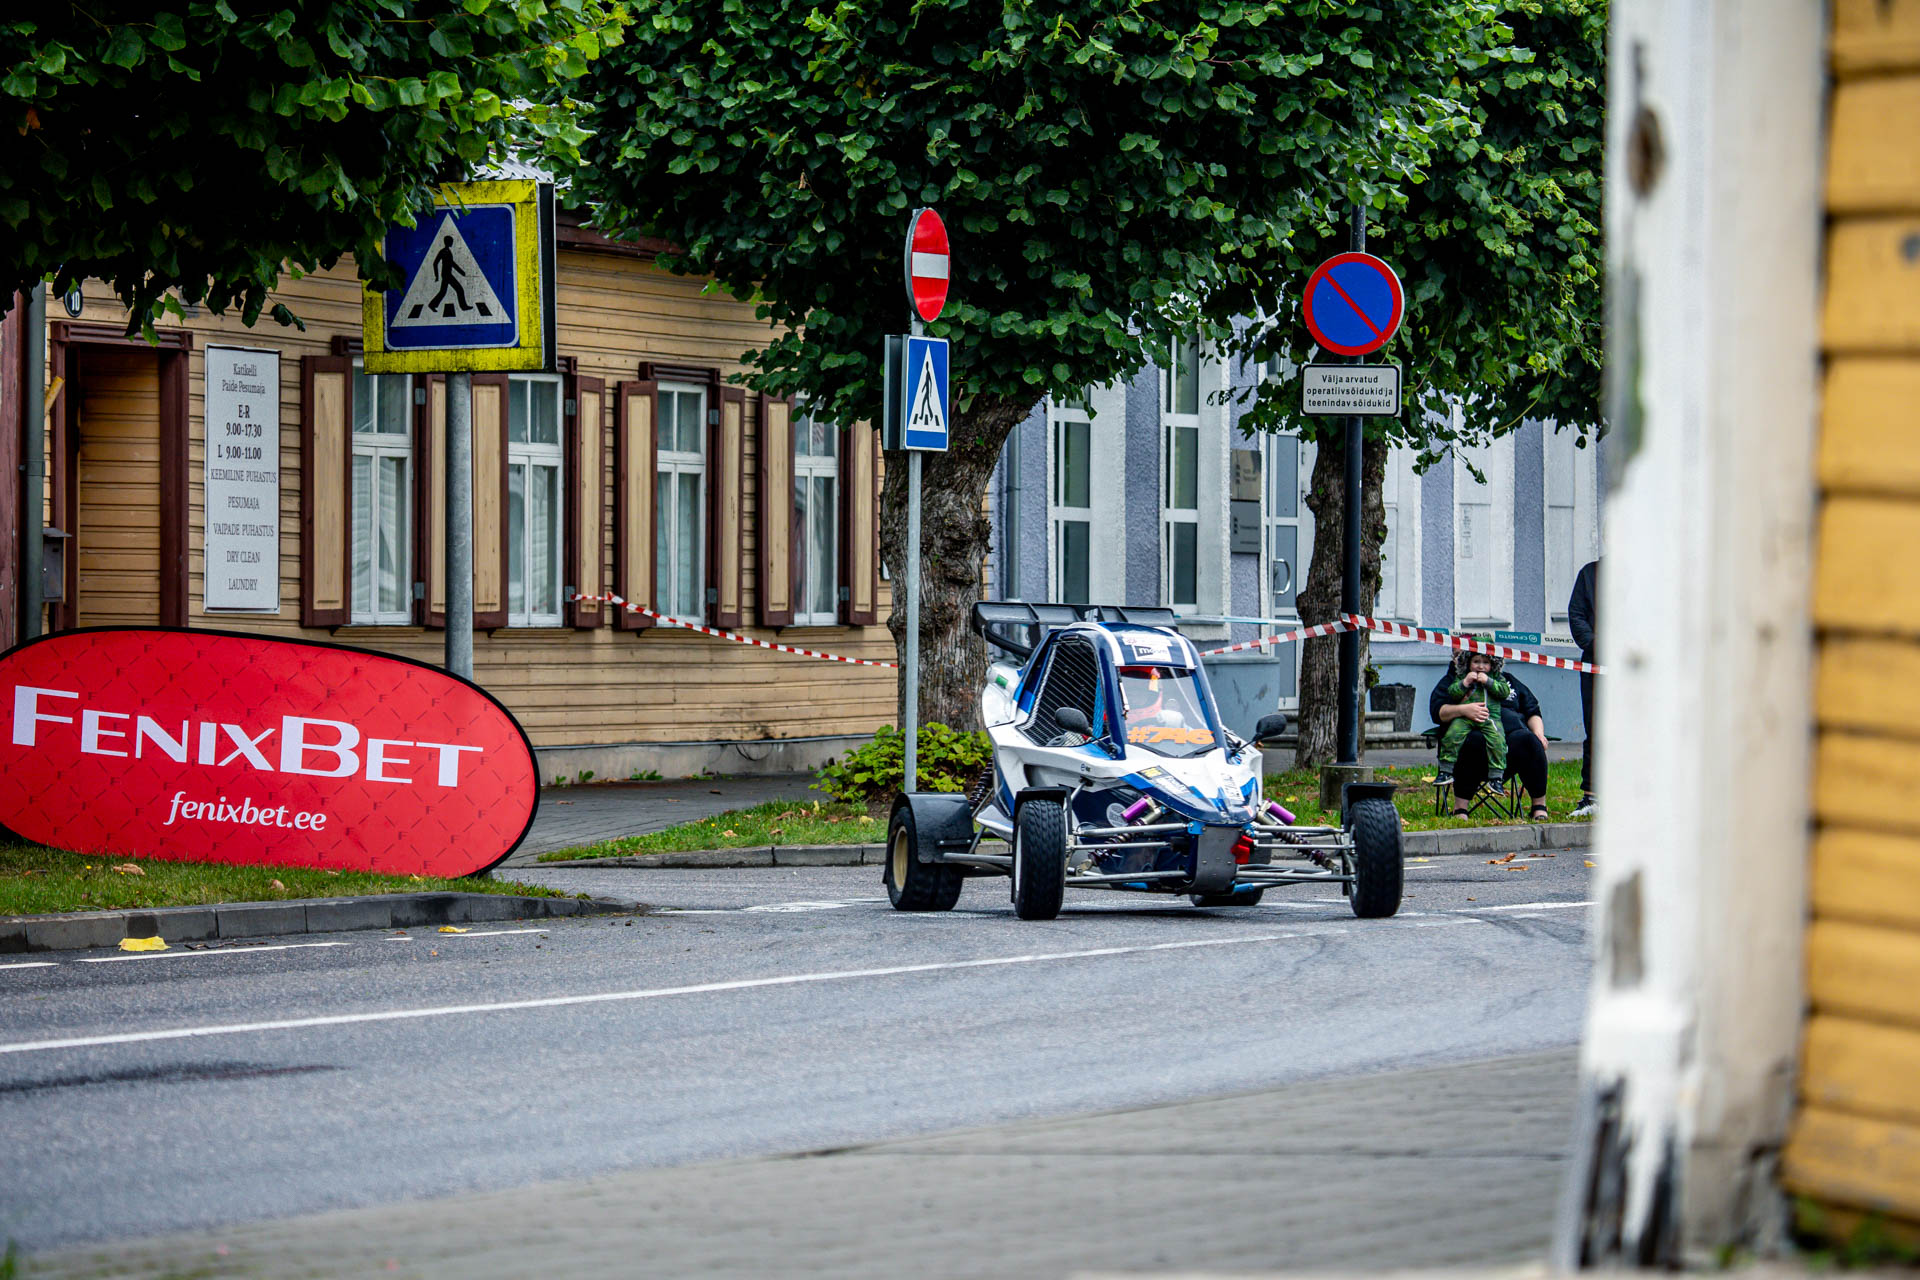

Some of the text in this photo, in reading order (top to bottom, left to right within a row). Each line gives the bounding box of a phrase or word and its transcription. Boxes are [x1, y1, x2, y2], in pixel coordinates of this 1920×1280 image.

[1322, 374, 1379, 384] Välja arvatud
[222, 379, 266, 397] Paide Pesumaja
[1306, 386, 1393, 397] operatiivsõidukid ja
[1308, 399, 1391, 407] teenindav sõidukid
[238, 404, 250, 419] E-R
[226, 422, 262, 438] 9.00-17.30
[217, 444, 262, 460] L 9.00-11.00
[210, 468, 277, 483] KEEMILINE PUHASTUS
[227, 496, 260, 510] PESUMAJA
[213, 523, 274, 537] VAIPADE PUHASTUS
[226, 550, 261, 563] DRY CLEAN
[228, 578, 258, 590] LAUNDRY
[163, 790, 327, 832] fenixbet.ee
